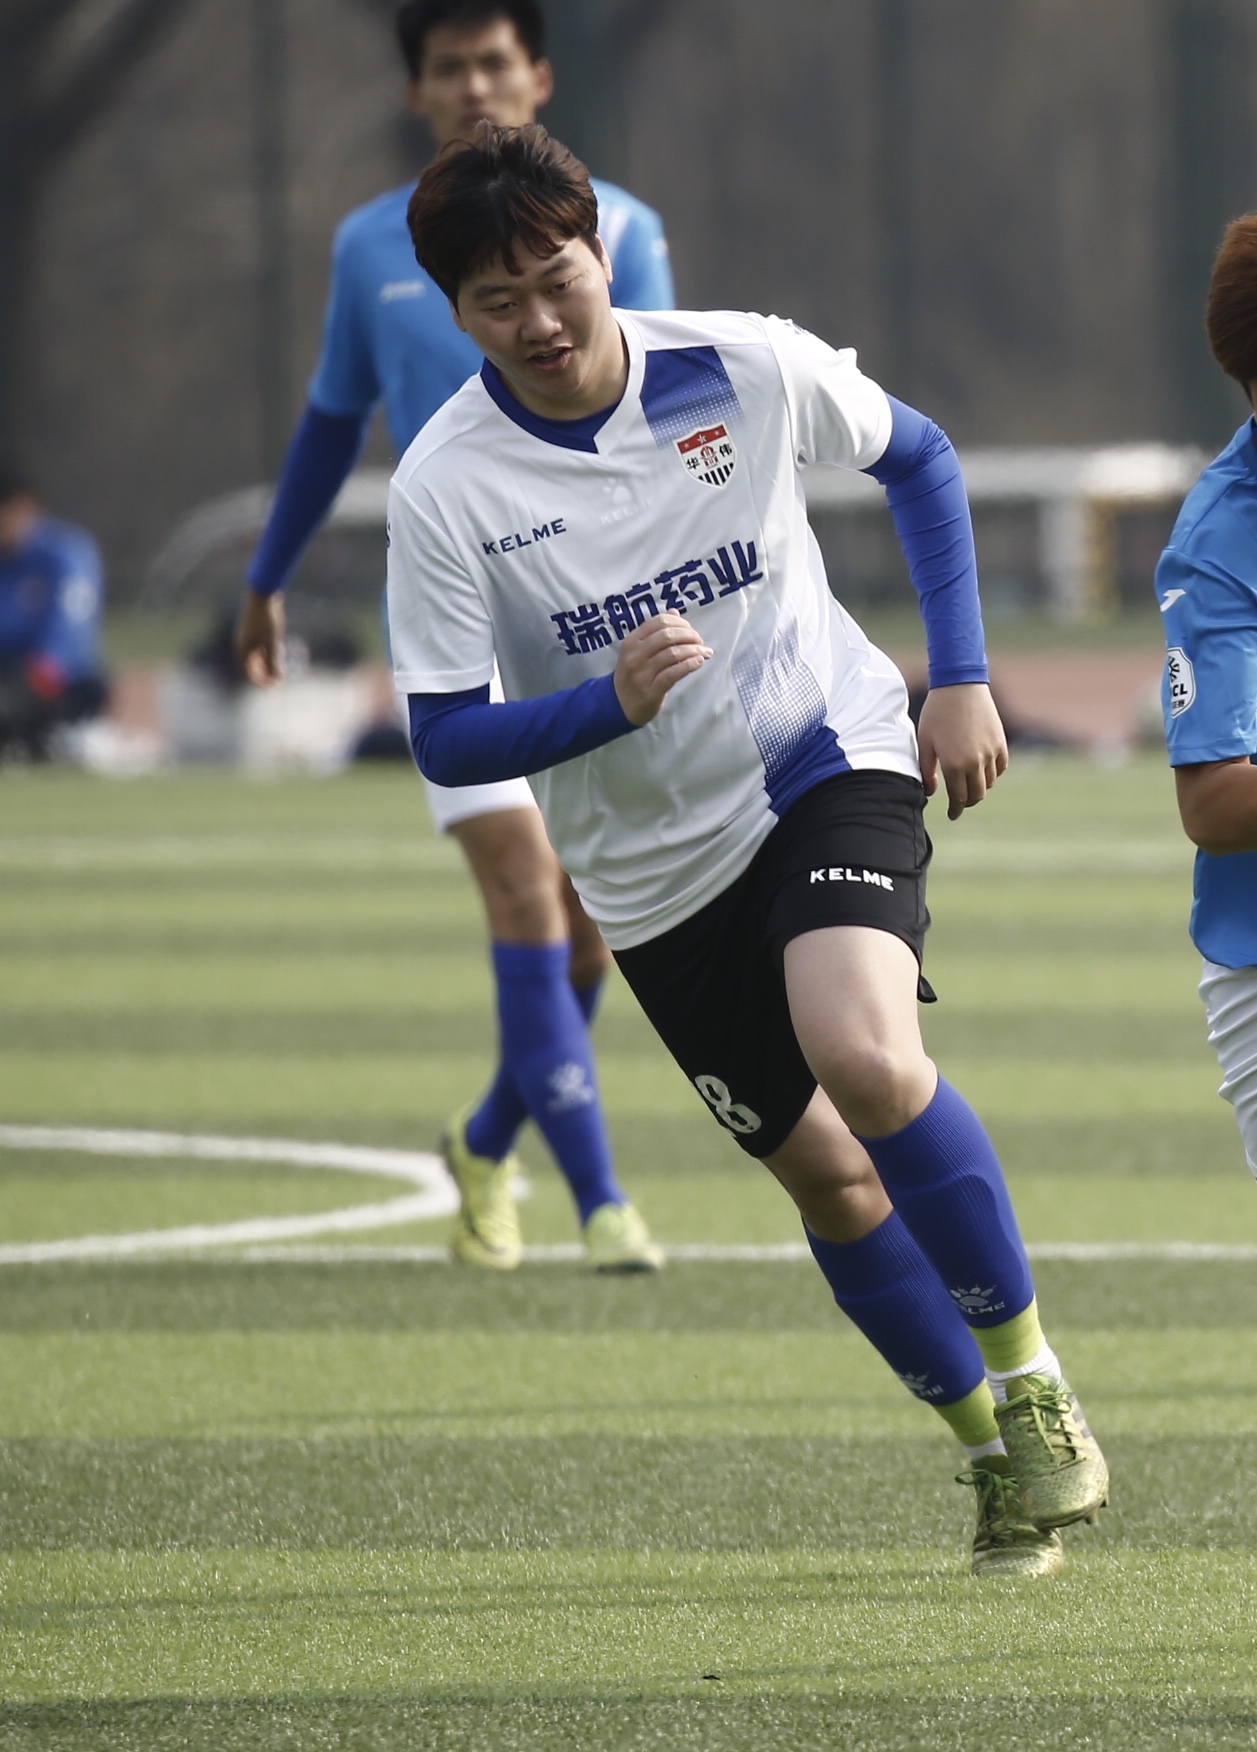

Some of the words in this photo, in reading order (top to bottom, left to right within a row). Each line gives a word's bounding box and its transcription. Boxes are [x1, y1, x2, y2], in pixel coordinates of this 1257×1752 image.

[482, 518, 567, 556] KELME
[550, 540, 763, 656] 瑞航药业
[1170, 683, 1189, 697] CL
[810, 867, 894, 892] KELME
[694, 1074, 762, 1134] 8
[955, 1300, 1006, 1315] LME
